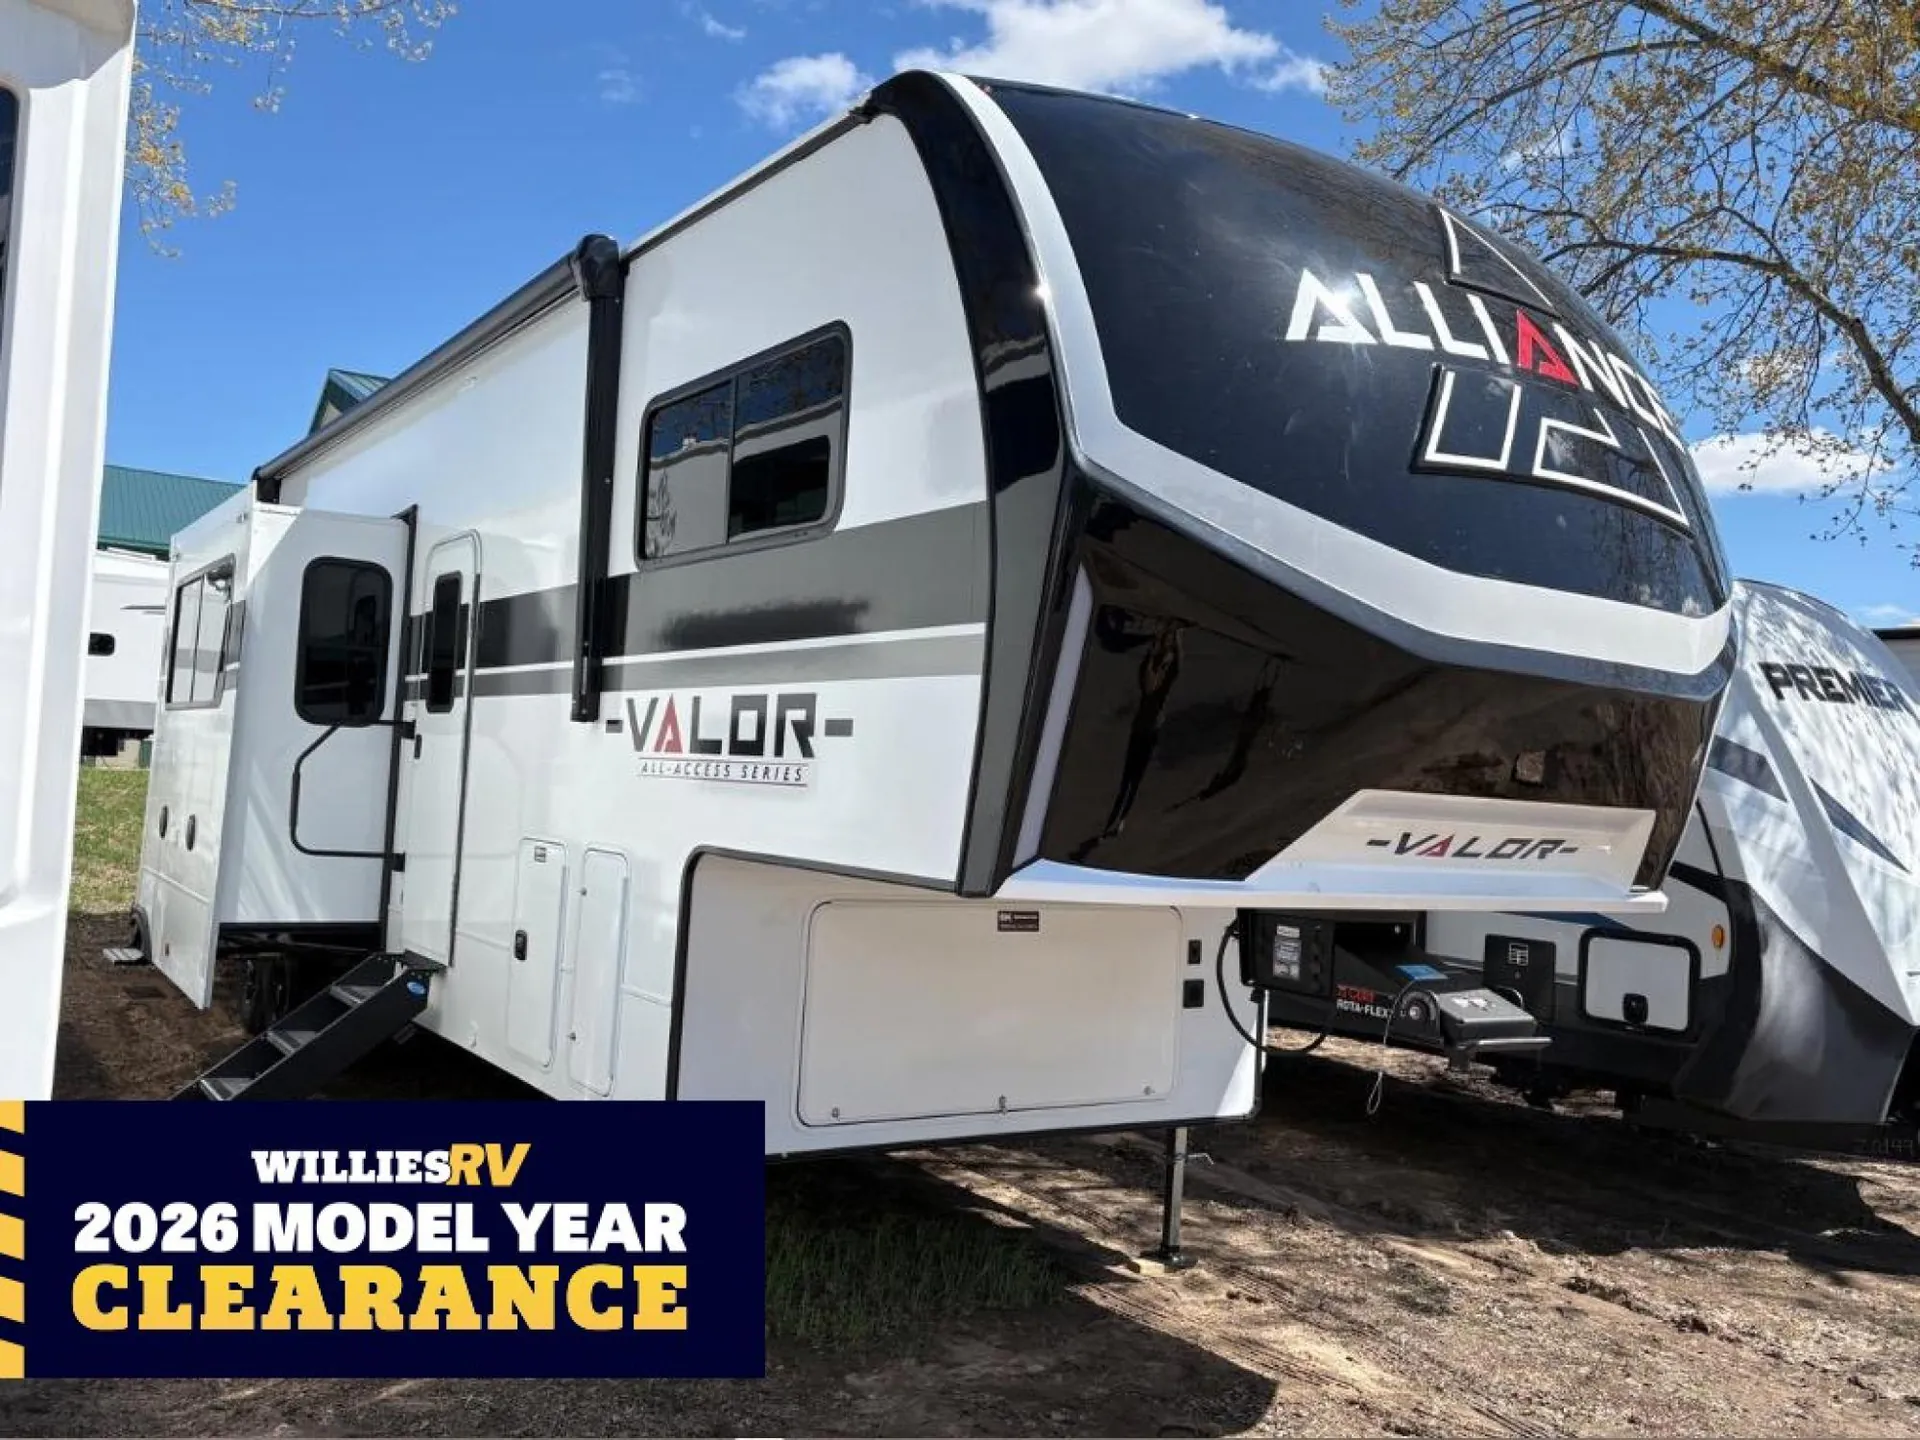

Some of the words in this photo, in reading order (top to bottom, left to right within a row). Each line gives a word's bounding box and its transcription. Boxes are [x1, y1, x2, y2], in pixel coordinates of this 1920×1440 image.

[1285, 267, 1686, 453] ALLIANCE
[641, 762, 731, 778] ALL-ACCESS
[741, 764, 803, 782] SERIES
